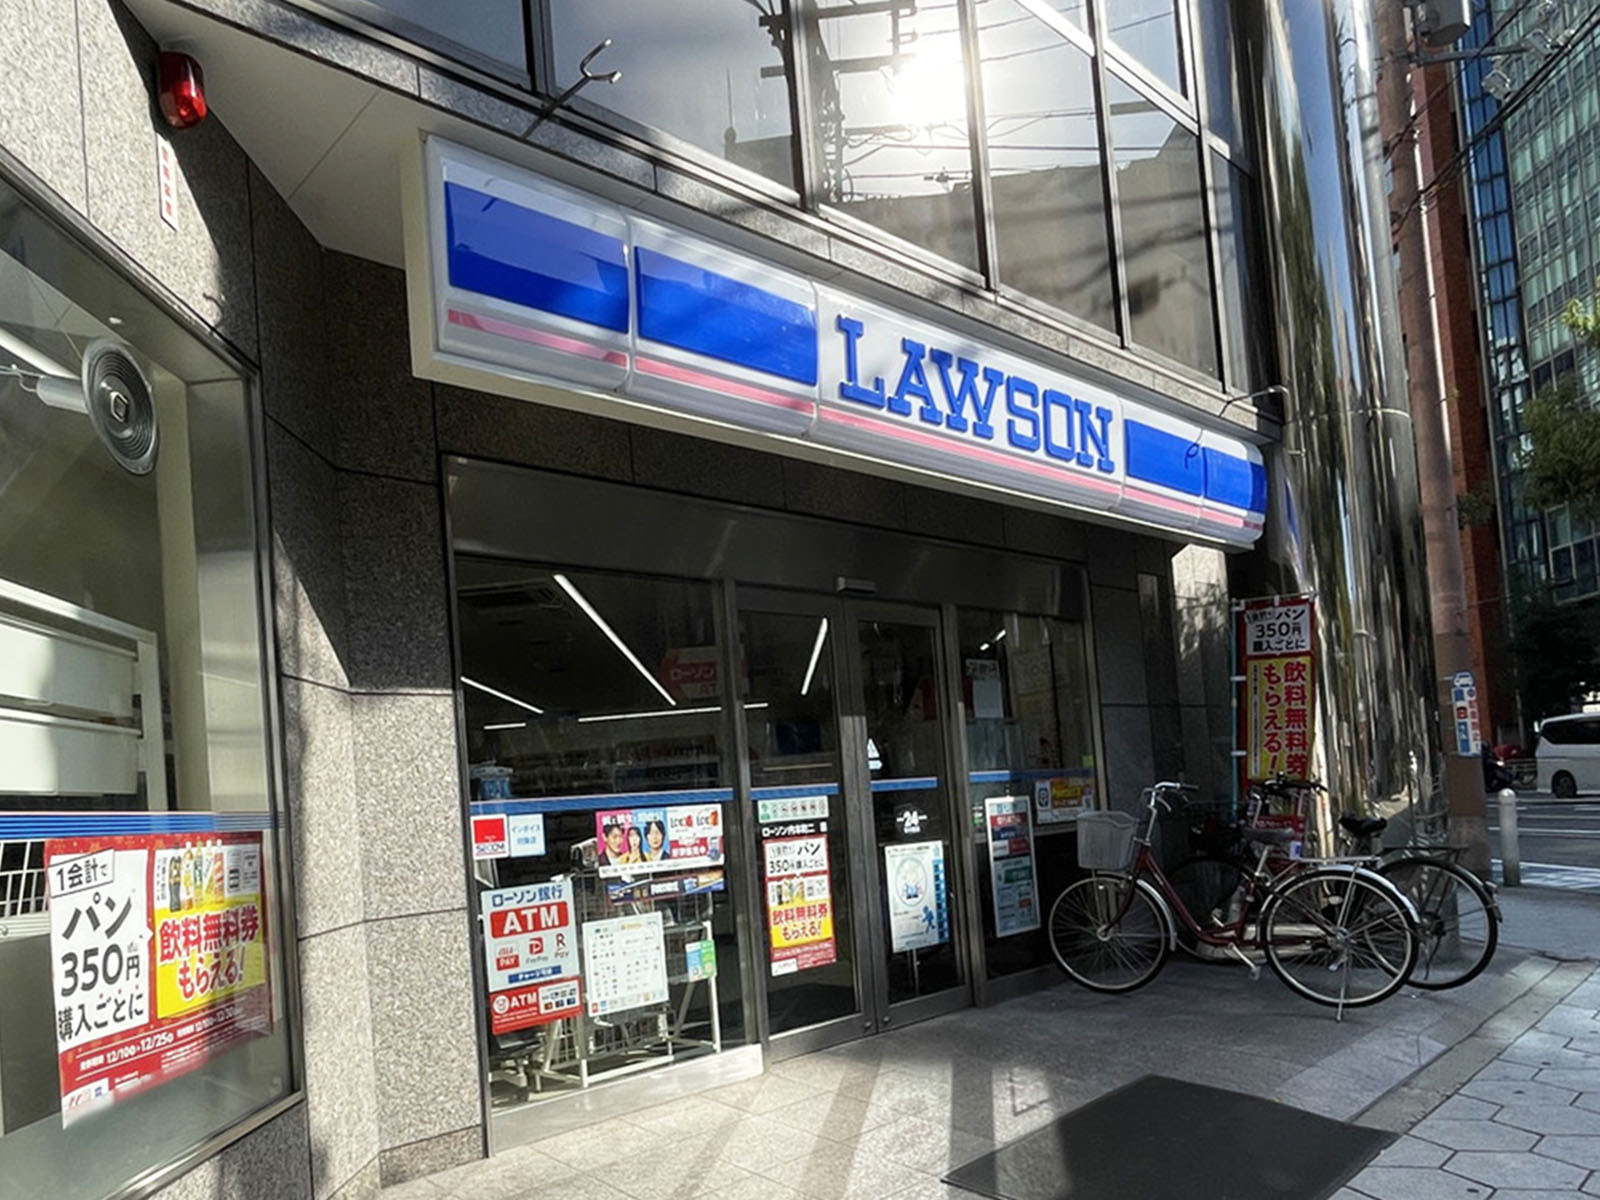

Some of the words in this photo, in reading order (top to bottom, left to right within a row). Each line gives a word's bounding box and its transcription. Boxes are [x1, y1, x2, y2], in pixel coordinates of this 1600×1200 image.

[835, 314, 1115, 474] LAWSON
[1276, 608, 1305, 620] パン
[1256, 621, 1302, 638] 350円
[1283, 661, 1308, 776] 飲料無料券
[797, 842, 820, 855] パン
[57, 858, 108, 892] 1会計で
[492, 885, 563, 908] ローソン銀行
[62, 891, 132, 940] パン
[503, 905, 560, 935] ATM
[773, 903, 827, 926] 飲料無料券
[159, 904, 259, 962] 飲料無料券
[61, 944, 140, 997] 350円
[499, 956, 517, 968] PAY
[511, 991, 537, 1008] ATM
[58, 993, 144, 1042] 購入ごとに
